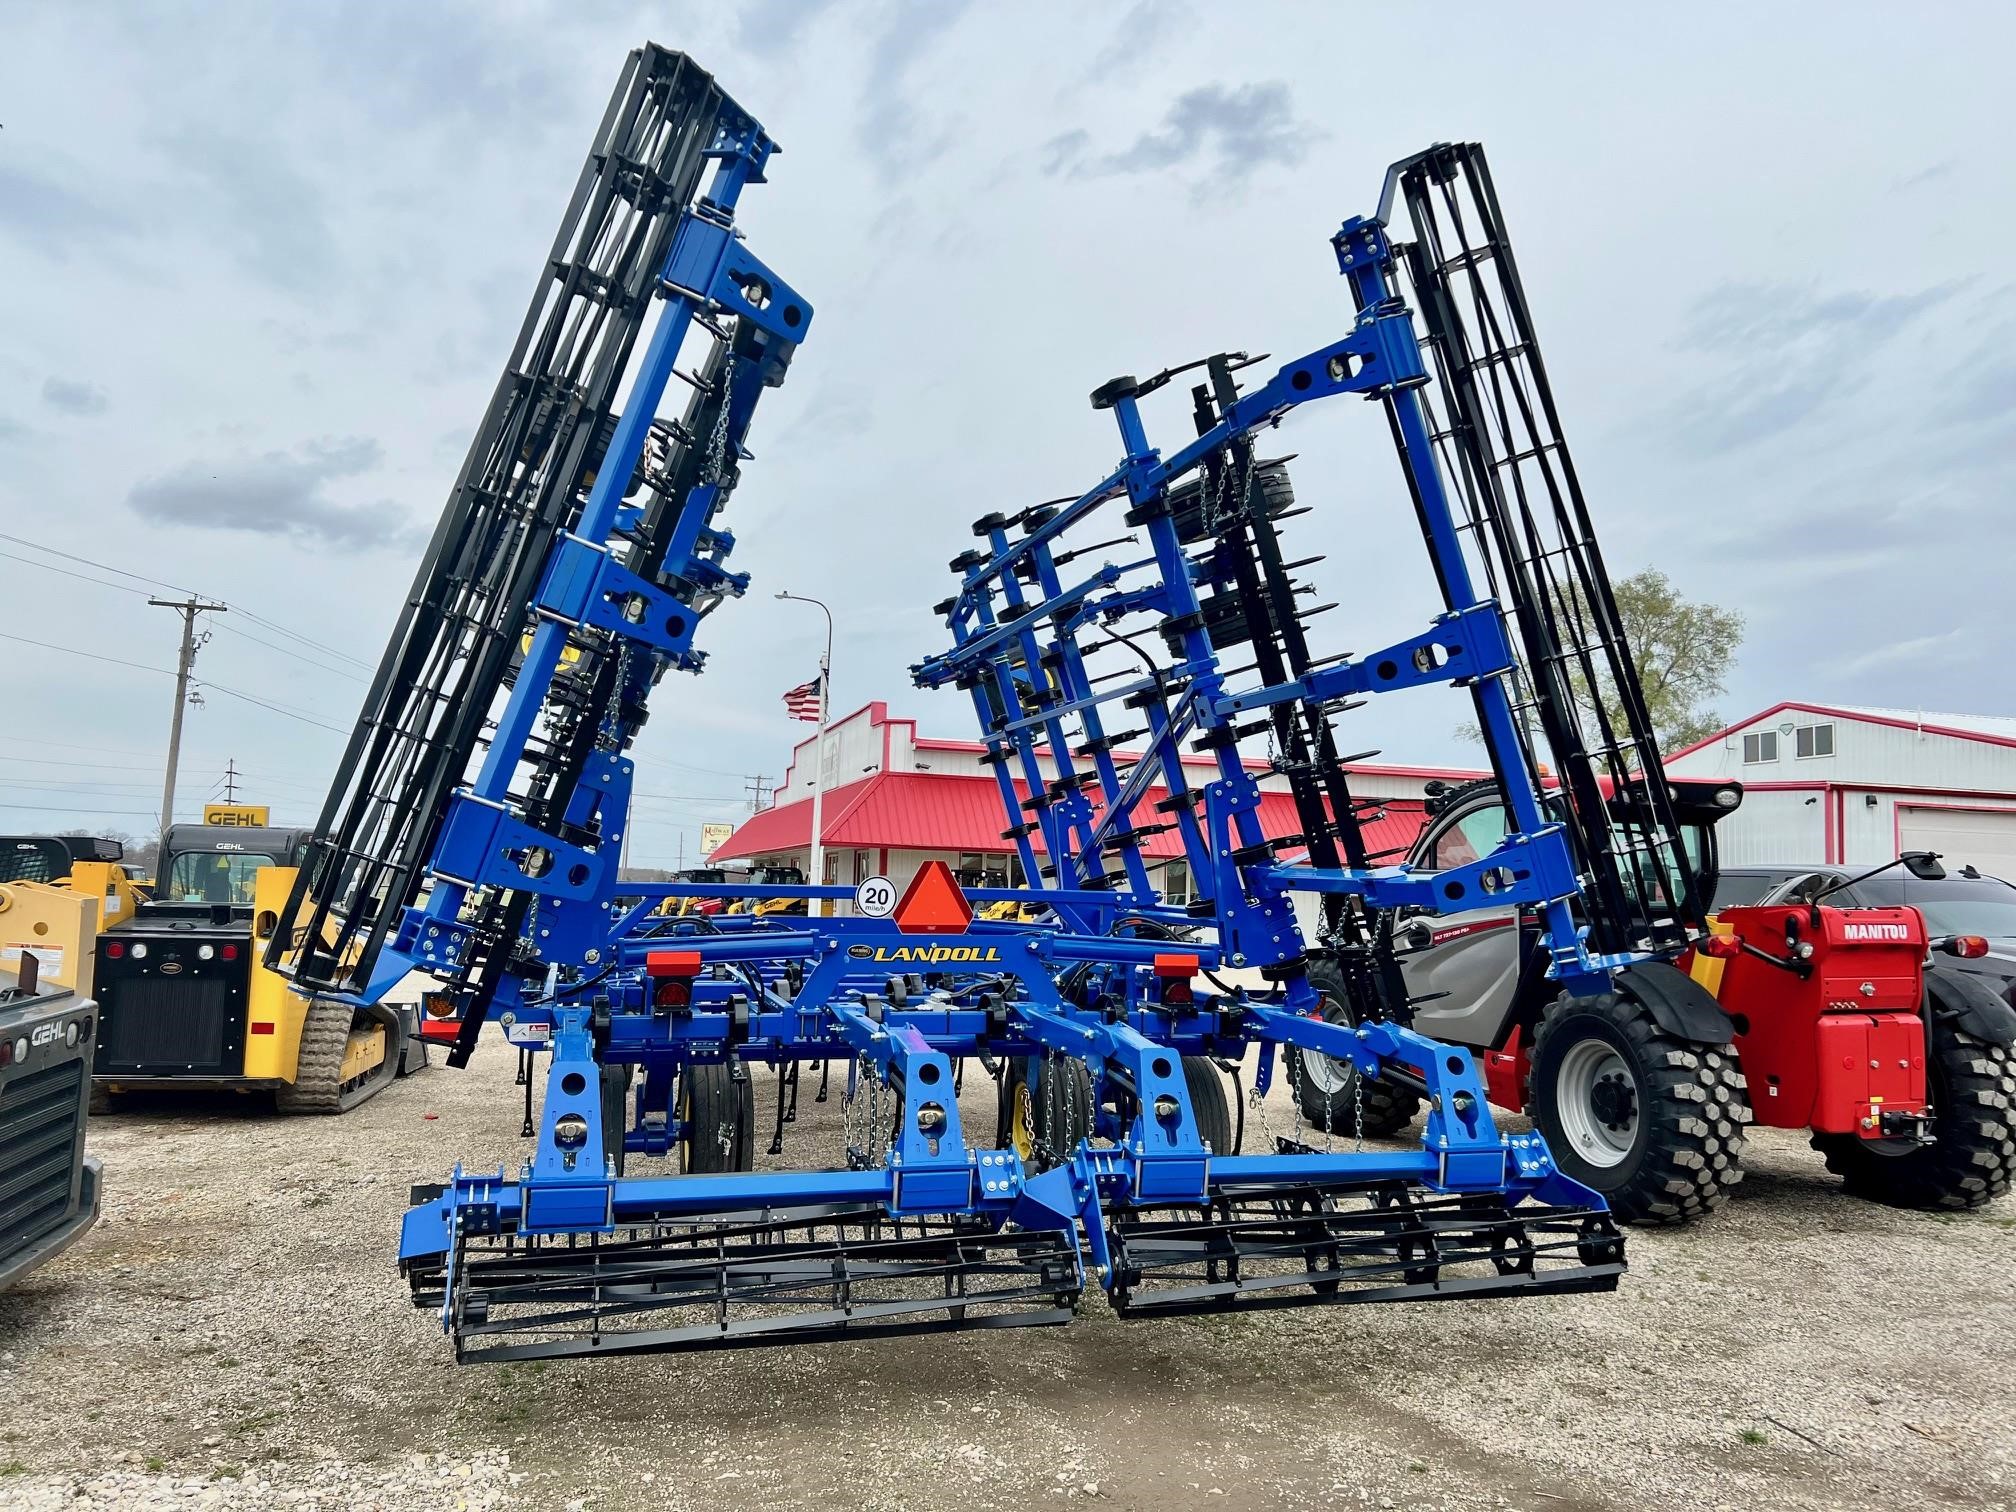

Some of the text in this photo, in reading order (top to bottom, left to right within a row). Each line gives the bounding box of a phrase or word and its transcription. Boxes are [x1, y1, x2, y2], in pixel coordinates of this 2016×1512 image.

[208, 812, 263, 827] GEHL
[215, 842, 245, 851] GEHL
[865, 888, 889, 905] 20
[764, 899, 783, 910] GEHL
[1844, 924, 1908, 940] MANITOU
[873, 947, 1002, 962] LANDOLL
[31, 1020, 65, 1046] GEHL
